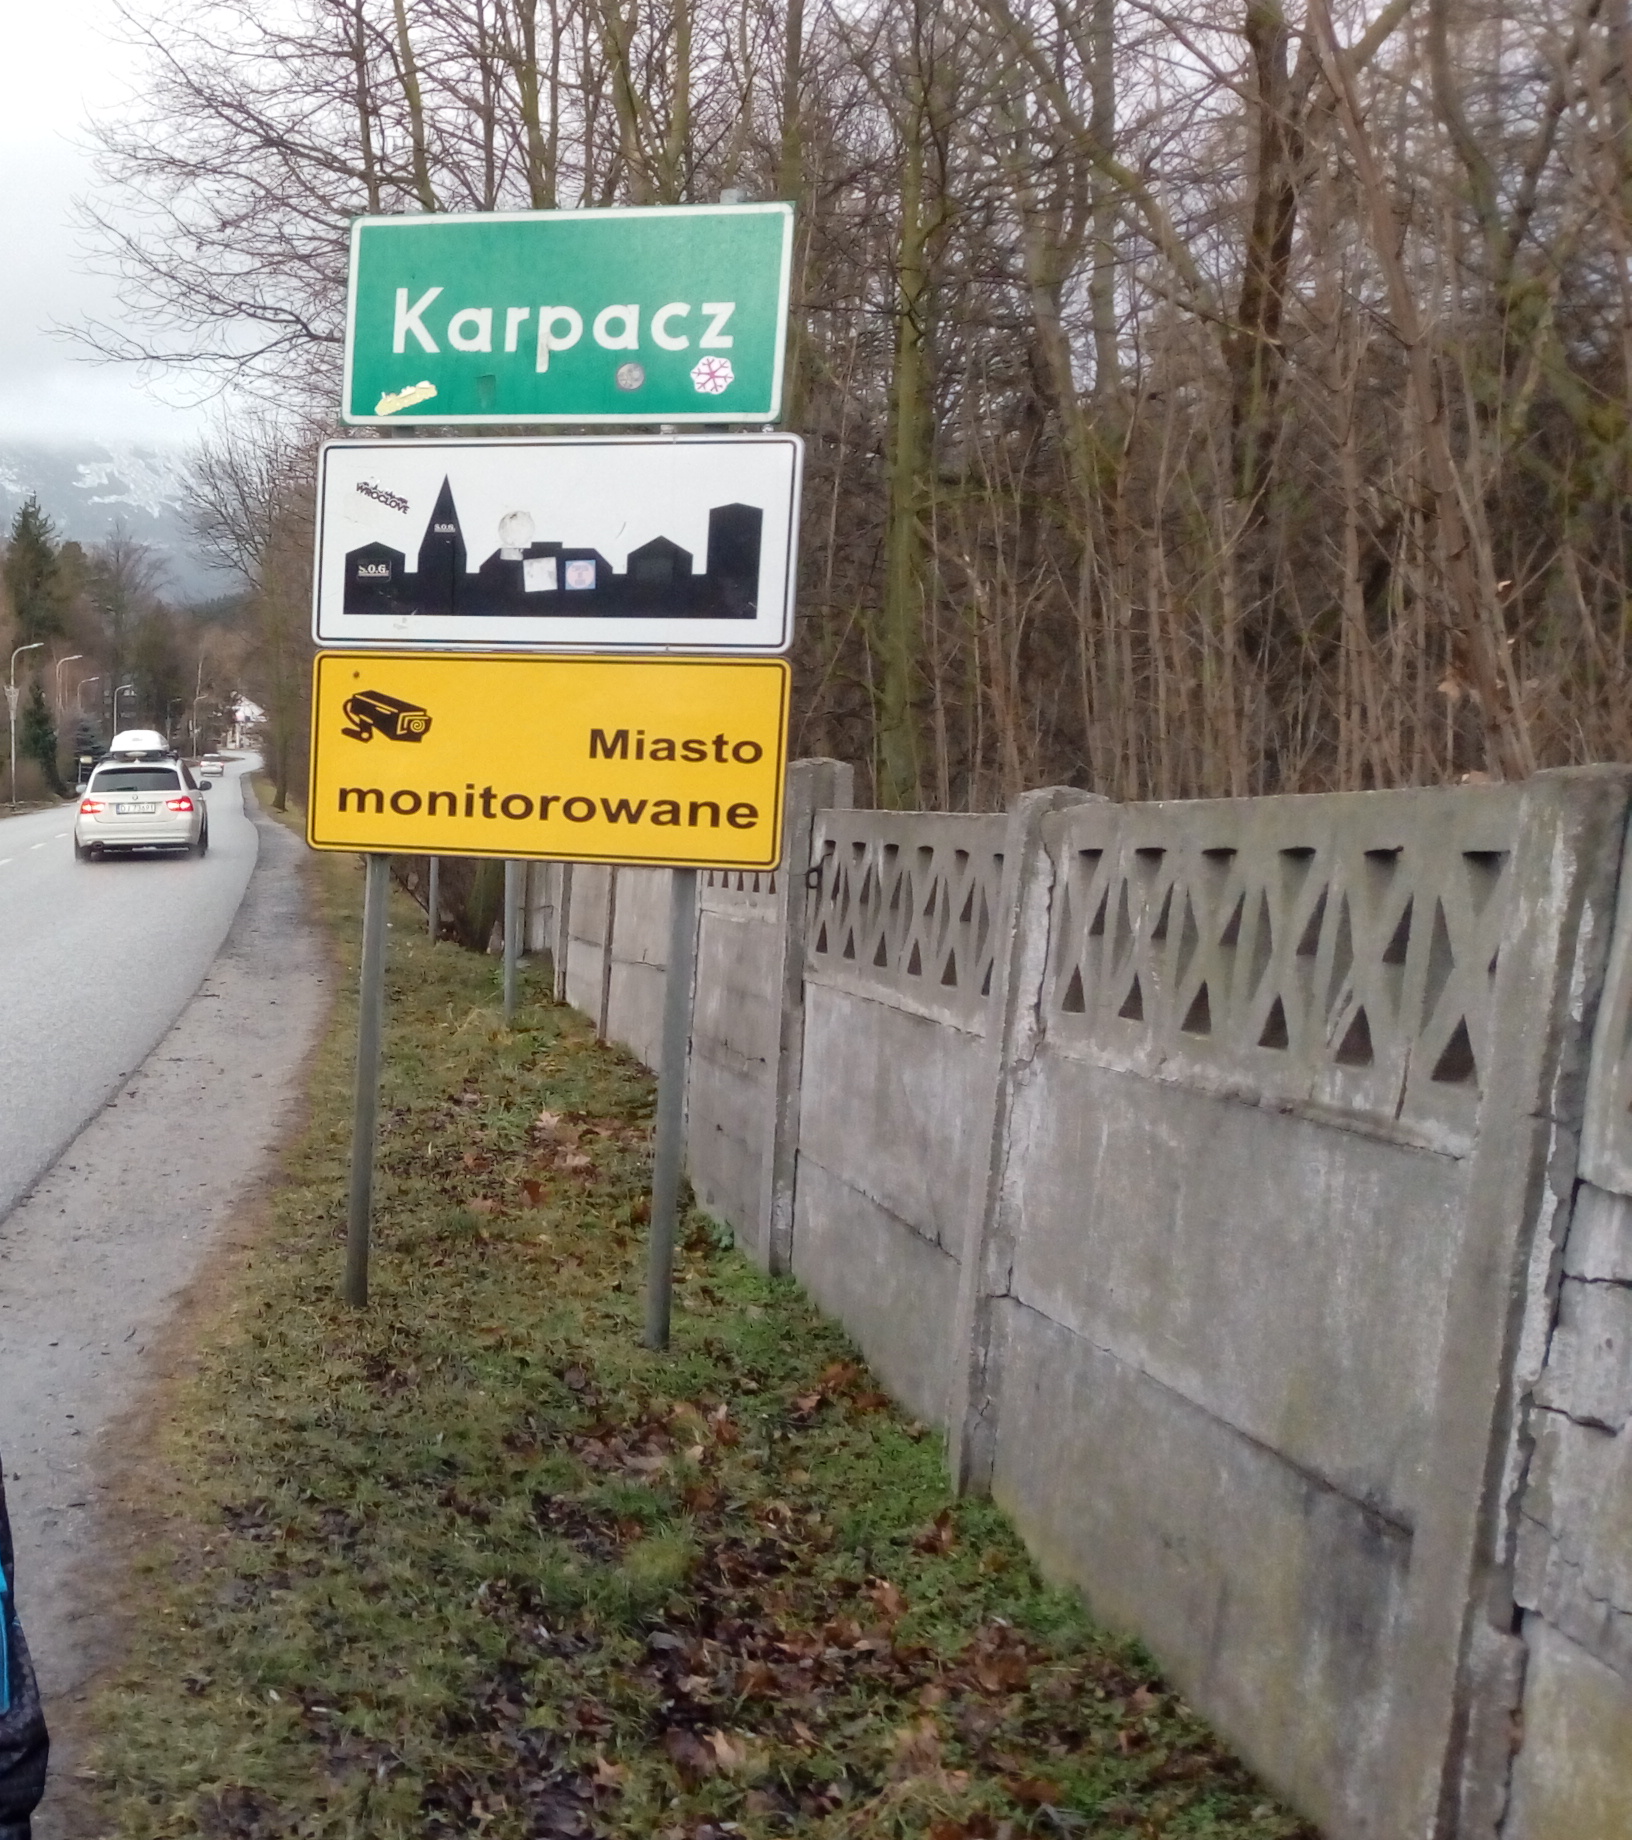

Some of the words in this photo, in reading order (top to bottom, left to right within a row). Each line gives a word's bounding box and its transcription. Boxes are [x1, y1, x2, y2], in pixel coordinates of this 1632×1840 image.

[392, 286, 736, 373] Karpacz
[356, 483, 410, 515] WROCLOVE
[358, 564, 390, 574] S.O.G.
[588, 728, 764, 764] Miasto
[337, 783, 760, 829] monitorowane
